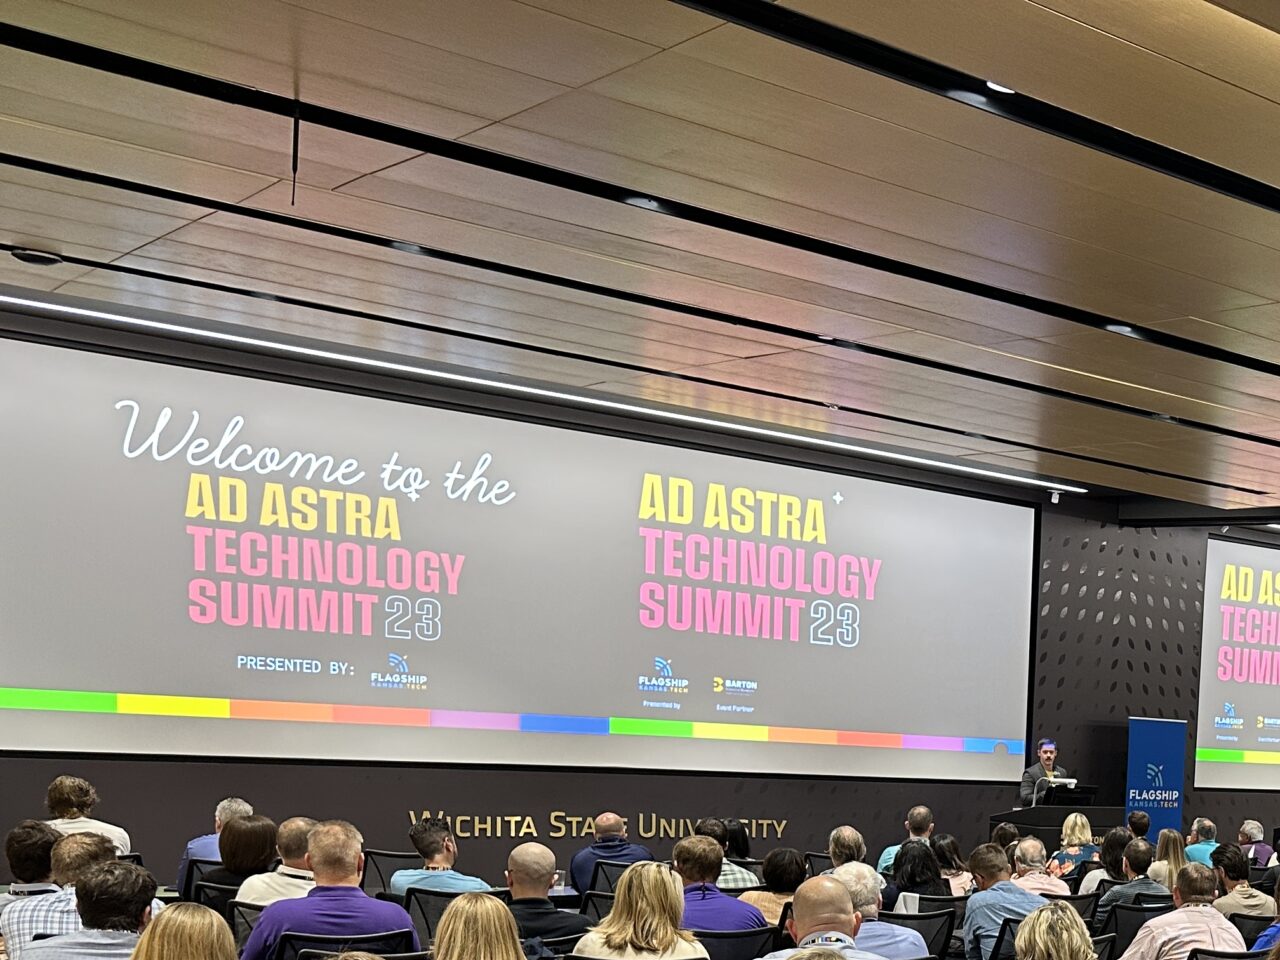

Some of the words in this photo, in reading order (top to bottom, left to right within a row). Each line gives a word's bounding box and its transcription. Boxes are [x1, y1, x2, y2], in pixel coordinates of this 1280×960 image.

[115, 400, 365, 486] Welcome
[380, 452, 430, 494] to
[443, 453, 516, 505] the
[185, 473, 248, 523] AD
[259, 482, 401, 540] ASTRA
[638, 472, 694, 525] AD
[703, 483, 827, 544] ASTRA
[186, 525, 465, 595] TECHNOLOGY
[639, 527, 882, 601] TECHNOLOGY
[1220, 563, 1254, 603] AD
[187, 578, 378, 636] SUMMIT
[639, 581, 806, 642] SUMMIT
[237, 655, 321, 673] PRESENTED
[329, 661, 354, 676] BY:
[370, 672, 428, 684] FLAGSHIP
[638, 676, 689, 688] FLAGSHIP
[725, 679, 758, 690] BARTON
[1129, 789, 1179, 801] FLAGSHIP
